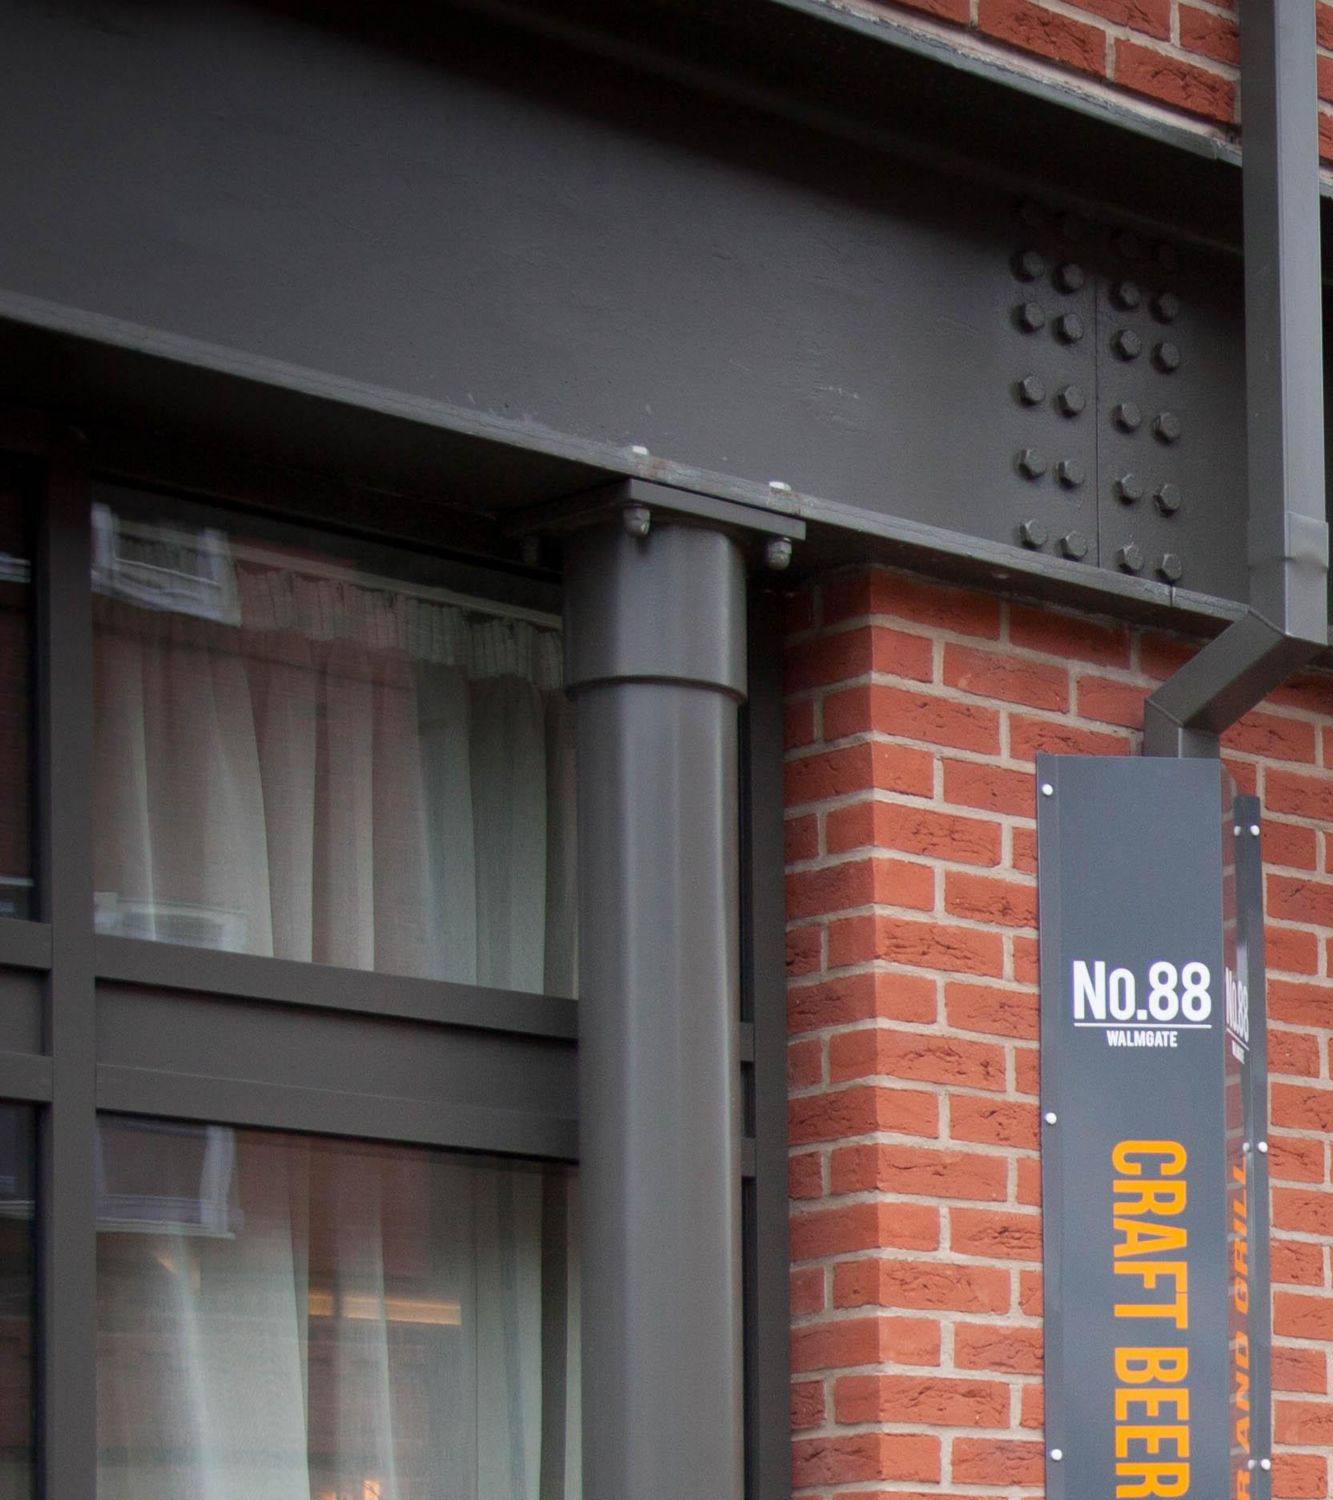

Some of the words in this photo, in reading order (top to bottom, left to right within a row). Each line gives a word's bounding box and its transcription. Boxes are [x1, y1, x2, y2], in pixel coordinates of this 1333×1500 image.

[1072, 959, 1212, 1022] No.88
[1106, 1030, 1178, 1048] WALMGATE
[1112, 1140, 1188, 1329] CRAFT
[1232, 1152, 1249, 1314] GRILL
[1235, 1330, 1251, 1453] AND
